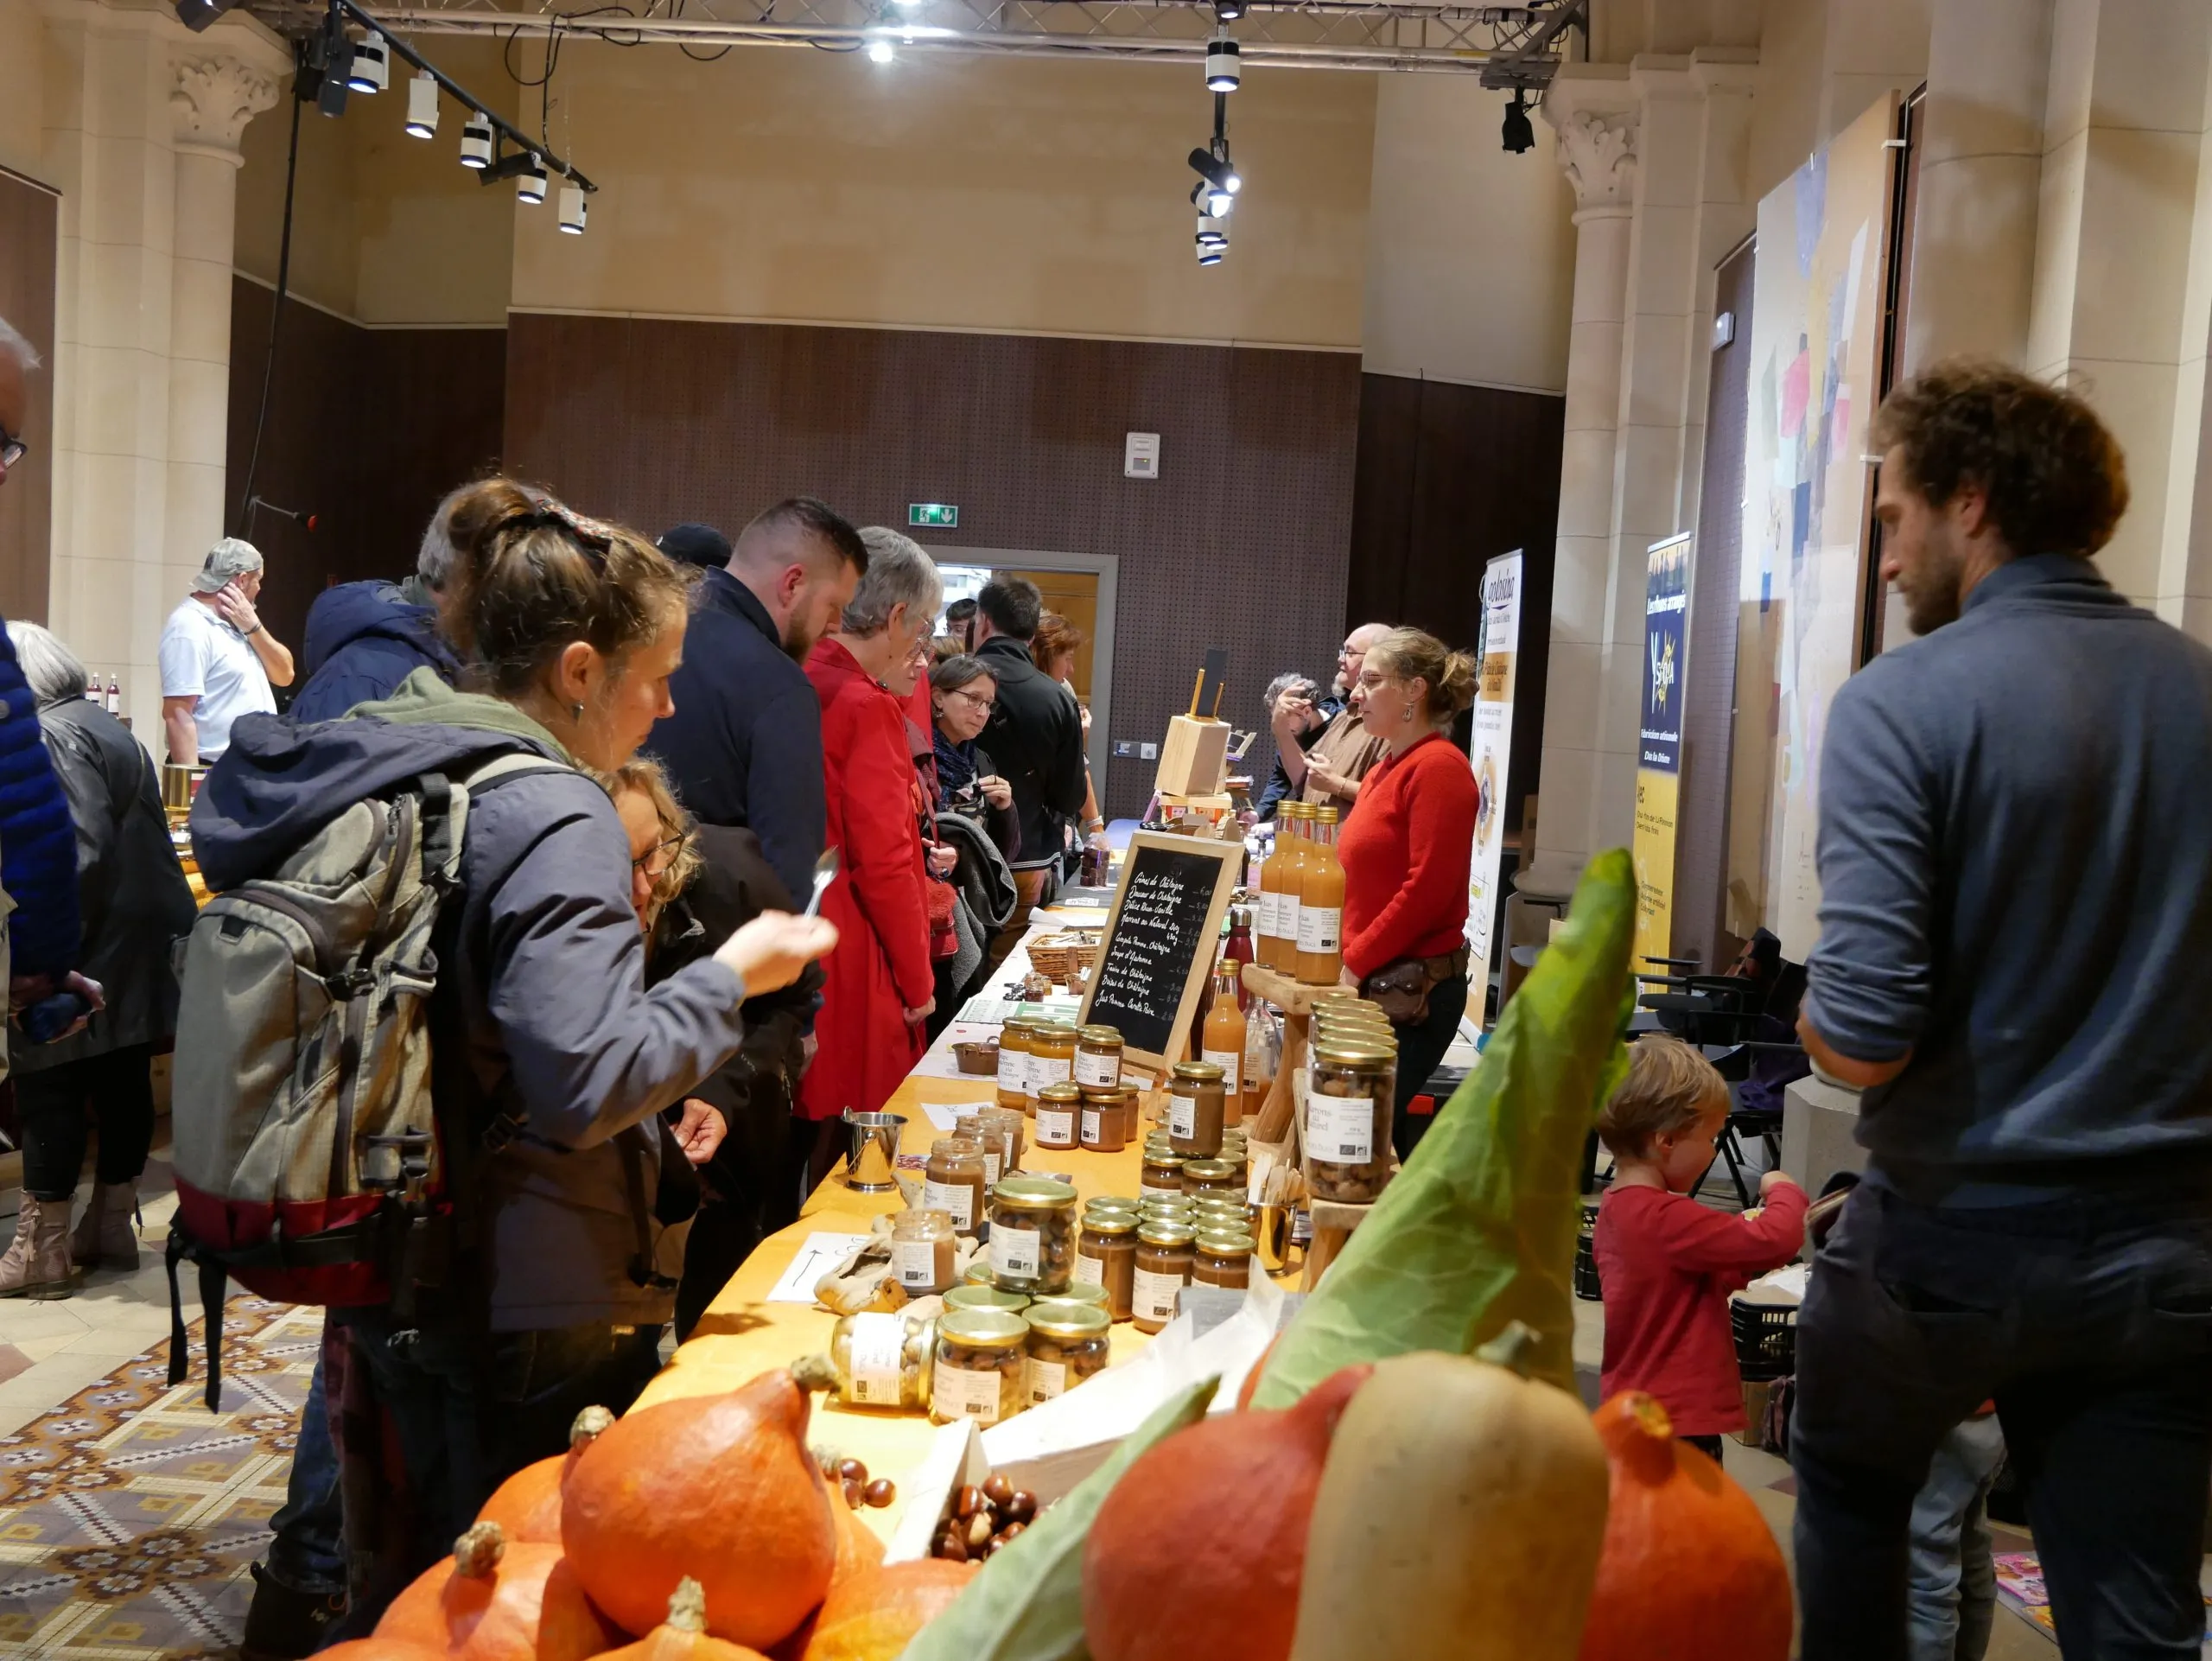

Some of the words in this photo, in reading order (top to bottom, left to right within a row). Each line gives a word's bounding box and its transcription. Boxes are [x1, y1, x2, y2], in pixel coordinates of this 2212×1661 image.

[1149, 875, 1158, 886] de
[1149, 890, 1156, 900] de
[1121, 966, 1128, 975] de
[1117, 979, 1124, 988] de
[1095, 990, 1108, 1007] Jus
